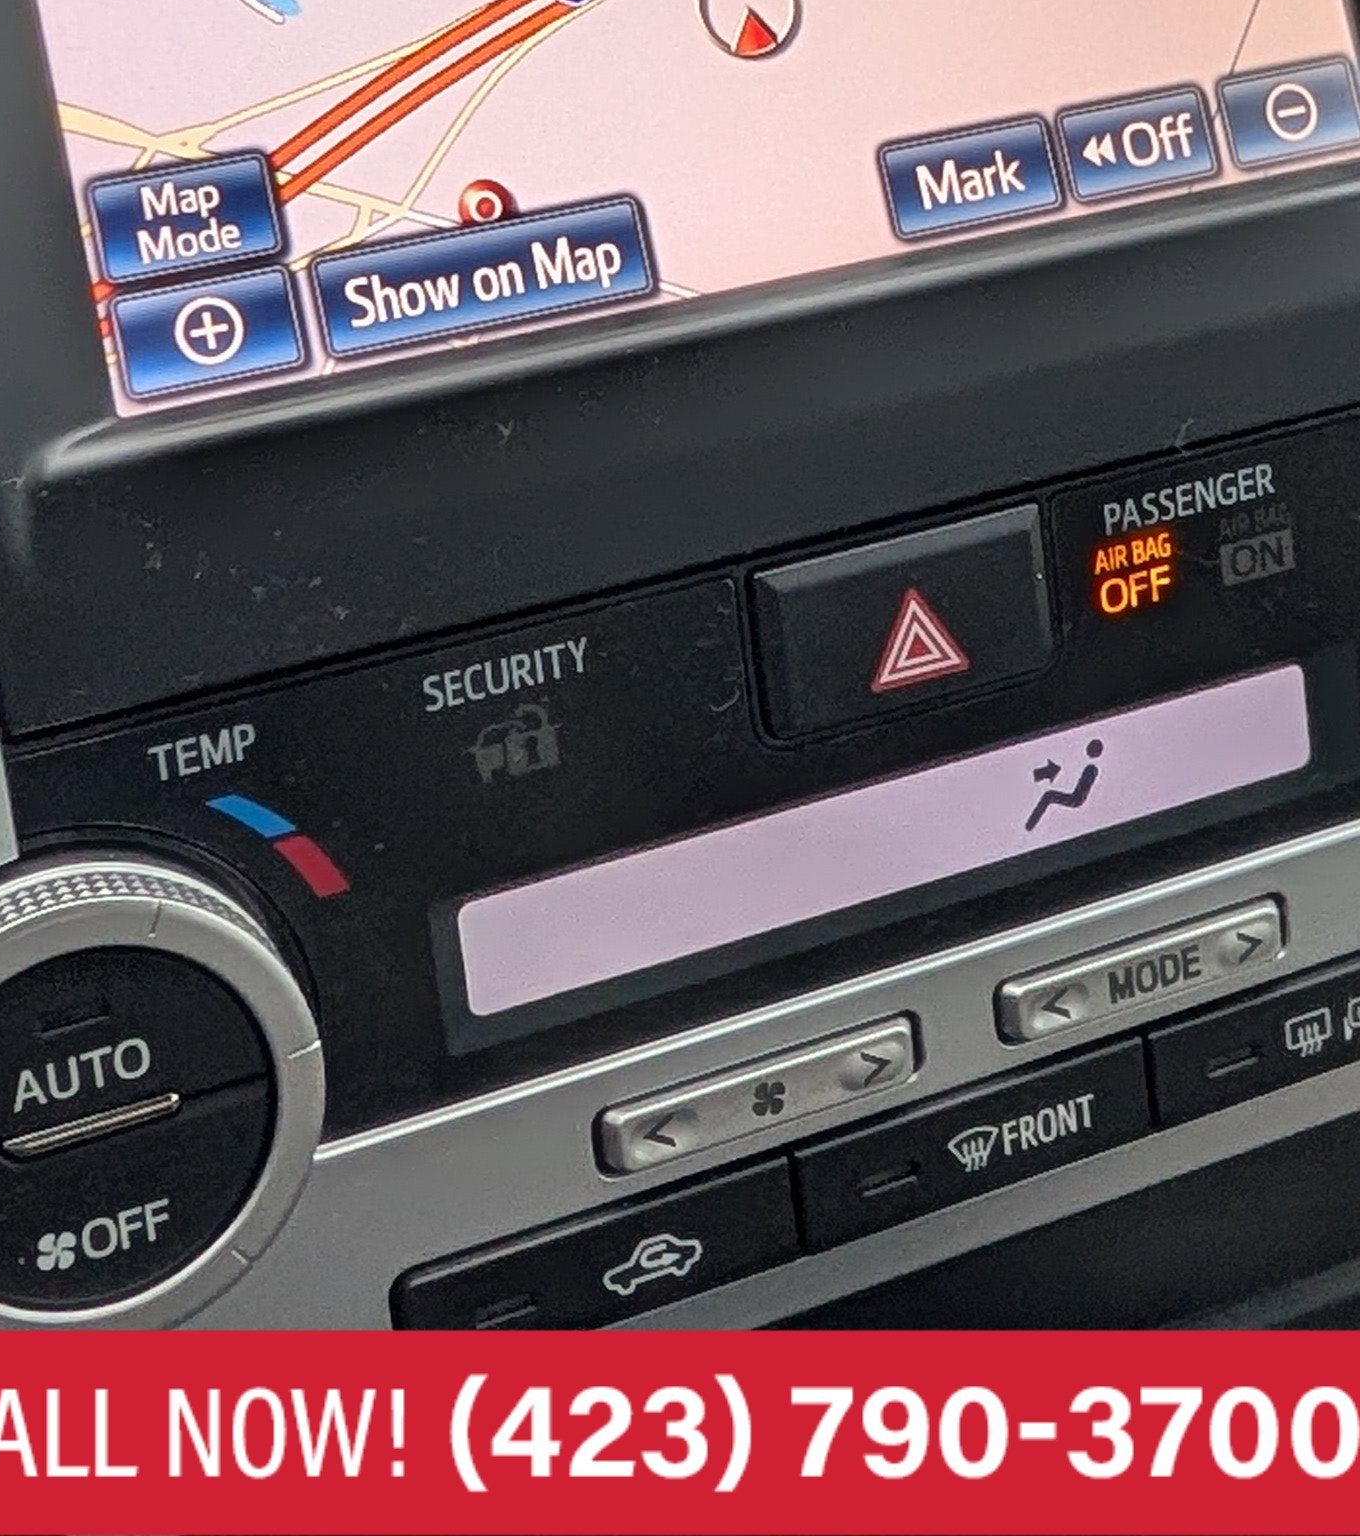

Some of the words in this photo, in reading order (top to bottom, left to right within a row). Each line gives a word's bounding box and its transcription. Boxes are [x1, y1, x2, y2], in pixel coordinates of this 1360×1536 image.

[1121, 113, 1195, 167] Off
[140, 181, 221, 222] Map
[915, 149, 1026, 210] Mark
[136, 219, 242, 265] Mode
[344, 276, 460, 328] Show
[473, 258, 525, 299] on
[530, 235, 622, 290] Map
[1103, 463, 1276, 537] PASSENGER
[1094, 544, 1129, 576] AIR
[1131, 532, 1172, 565] BAG
[1231, 536, 1285, 578] ON
[1100, 565, 1171, 614] OFF
[422, 636, 588, 712] SECURITY
[147, 723, 256, 781] TEMP
[1107, 944, 1202, 1004] MODE
[13, 1037, 151, 1114] AUTO
[1002, 1093, 1095, 1156] FRONT
[81, 1197, 170, 1259] OFF
